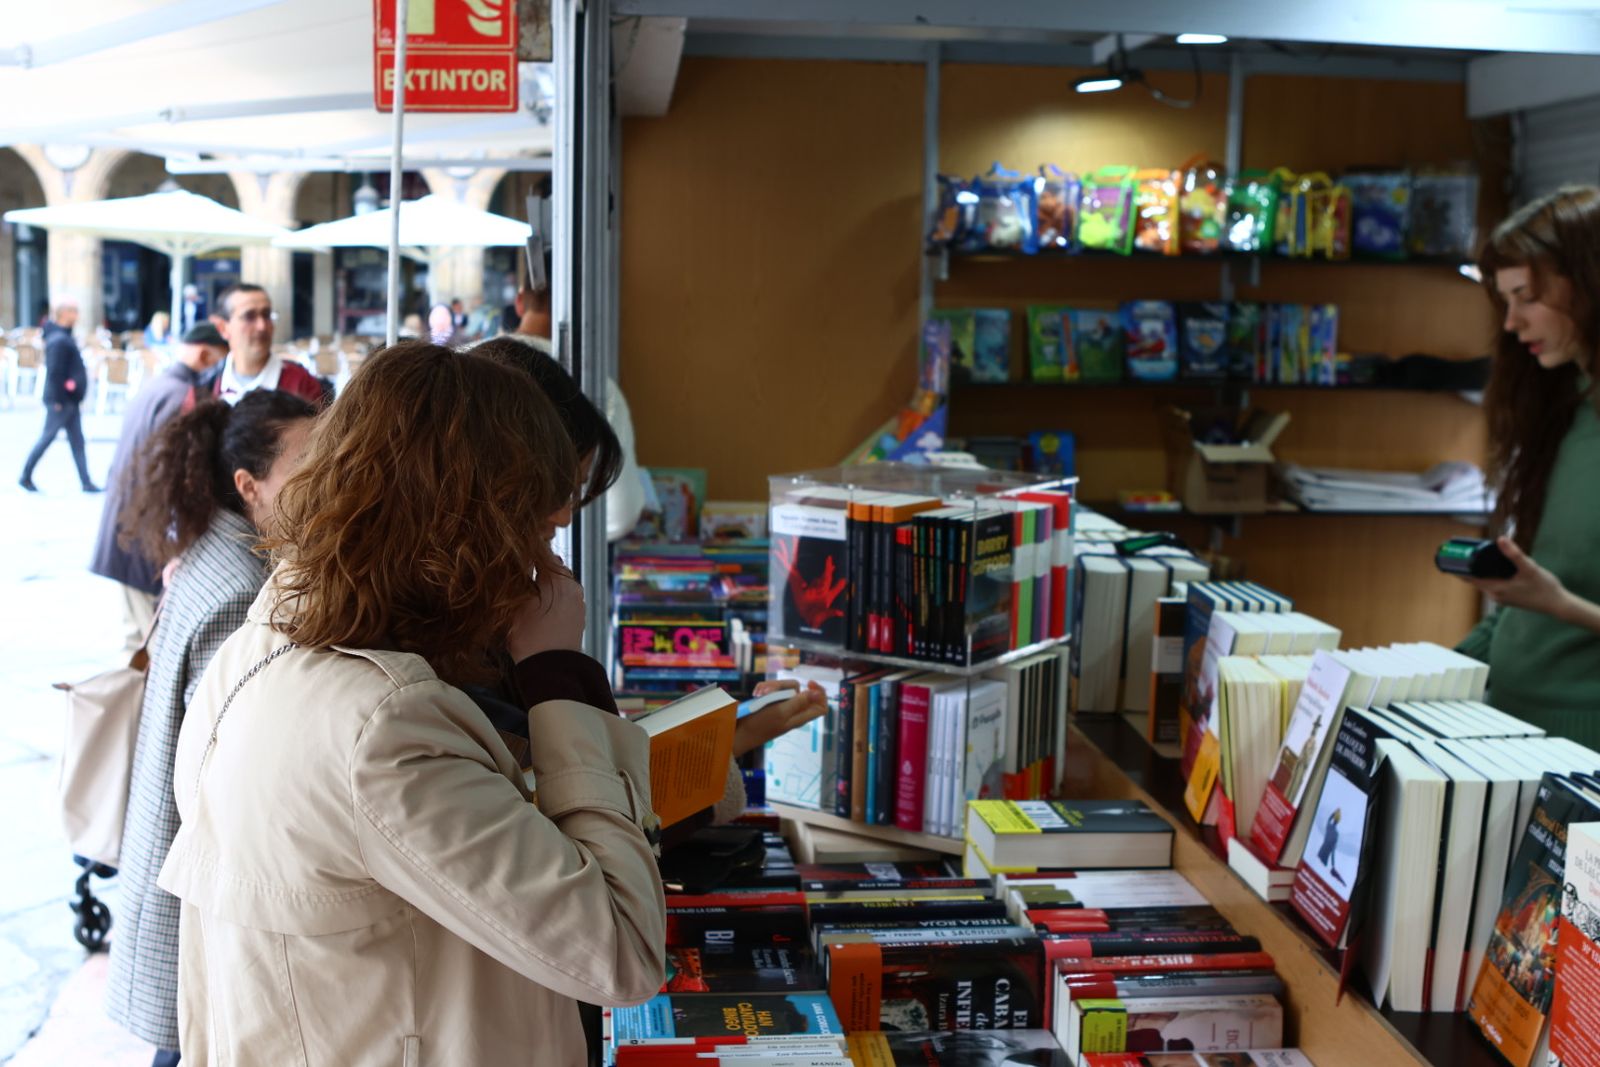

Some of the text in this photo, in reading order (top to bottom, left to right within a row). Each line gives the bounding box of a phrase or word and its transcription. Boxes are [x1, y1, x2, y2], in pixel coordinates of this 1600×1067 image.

[383, 68, 507, 92] EXTINTOR
[956, 980, 973, 1030] INFIE
[994, 978, 1011, 1029] CABA
[722, 1007, 741, 1031] BINGO
[737, 1002, 759, 1036] CANTADO
[759, 1010, 774, 1027] HAN
